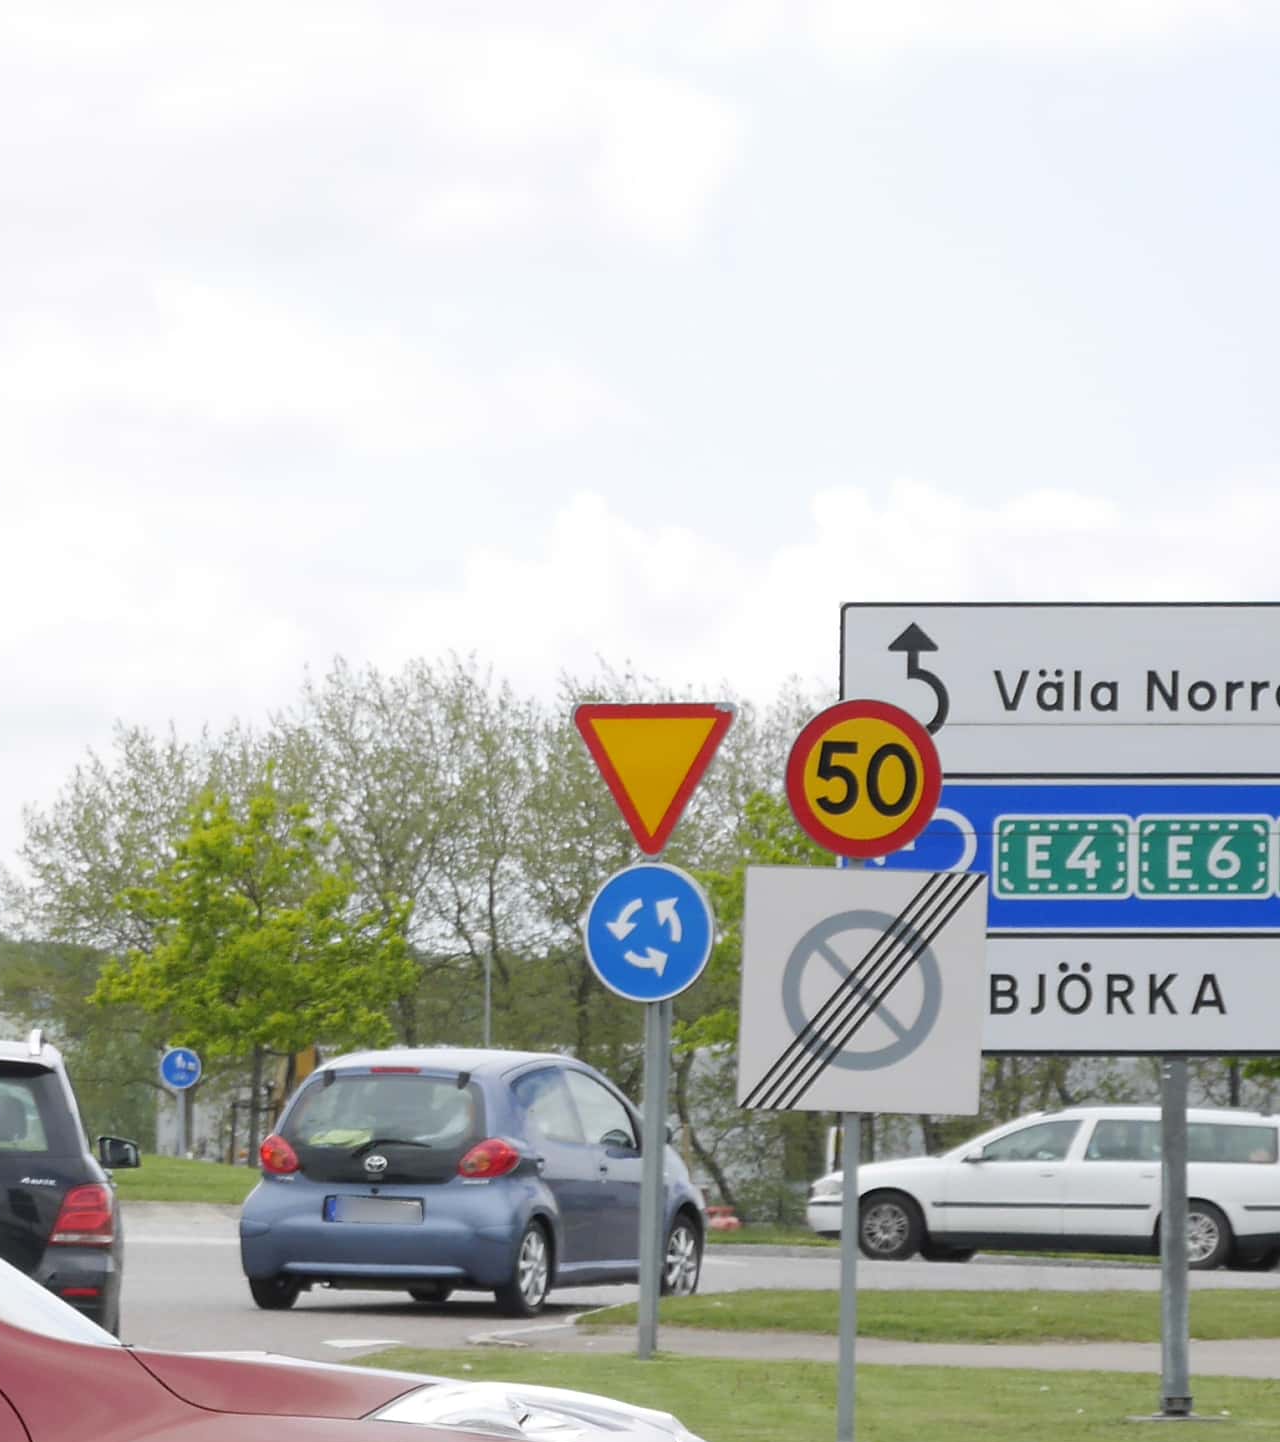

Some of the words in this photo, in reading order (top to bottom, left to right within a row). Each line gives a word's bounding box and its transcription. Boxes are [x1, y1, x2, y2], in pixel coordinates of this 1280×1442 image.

[993, 669, 1119, 712] Väla
[1146, 670, 1280, 712] Norr
[816, 741, 917, 816] 50
[989, 962, 1227, 1015] BJÖRKA
